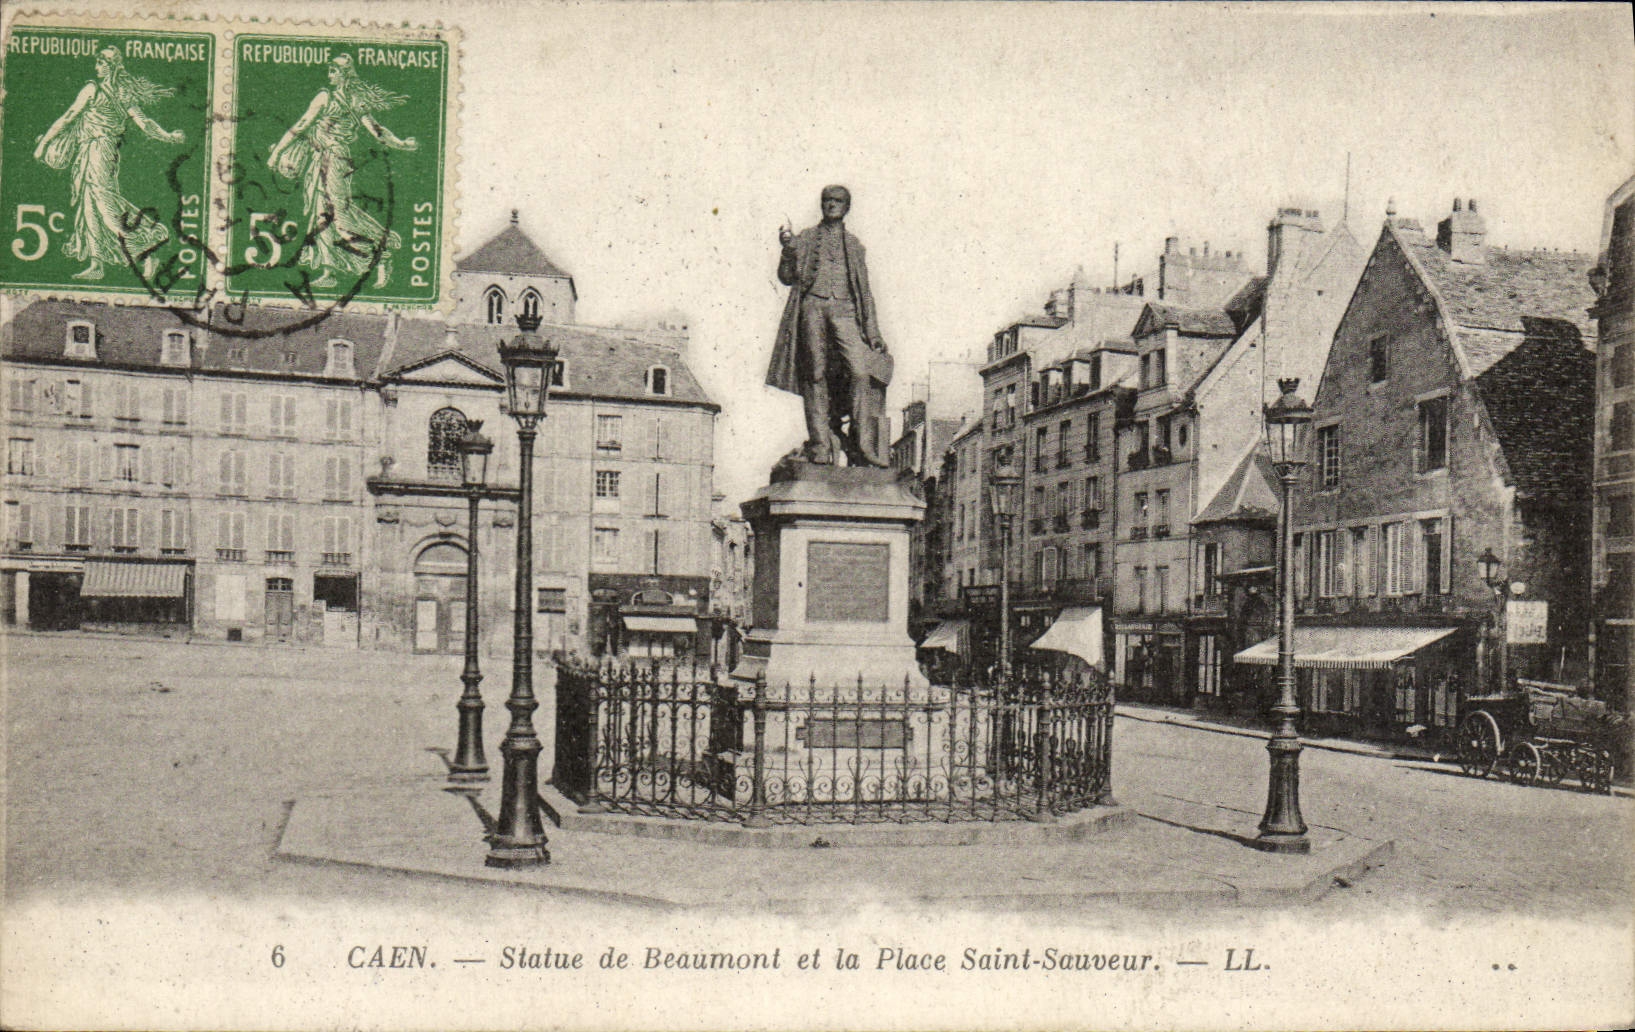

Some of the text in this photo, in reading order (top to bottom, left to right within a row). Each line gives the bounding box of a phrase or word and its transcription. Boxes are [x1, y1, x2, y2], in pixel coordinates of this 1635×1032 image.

[125, 40, 206, 62] FRANÇAISE
[358, 48, 438, 69] FRANÇAISE
[411, 201, 433, 287] POSTES
